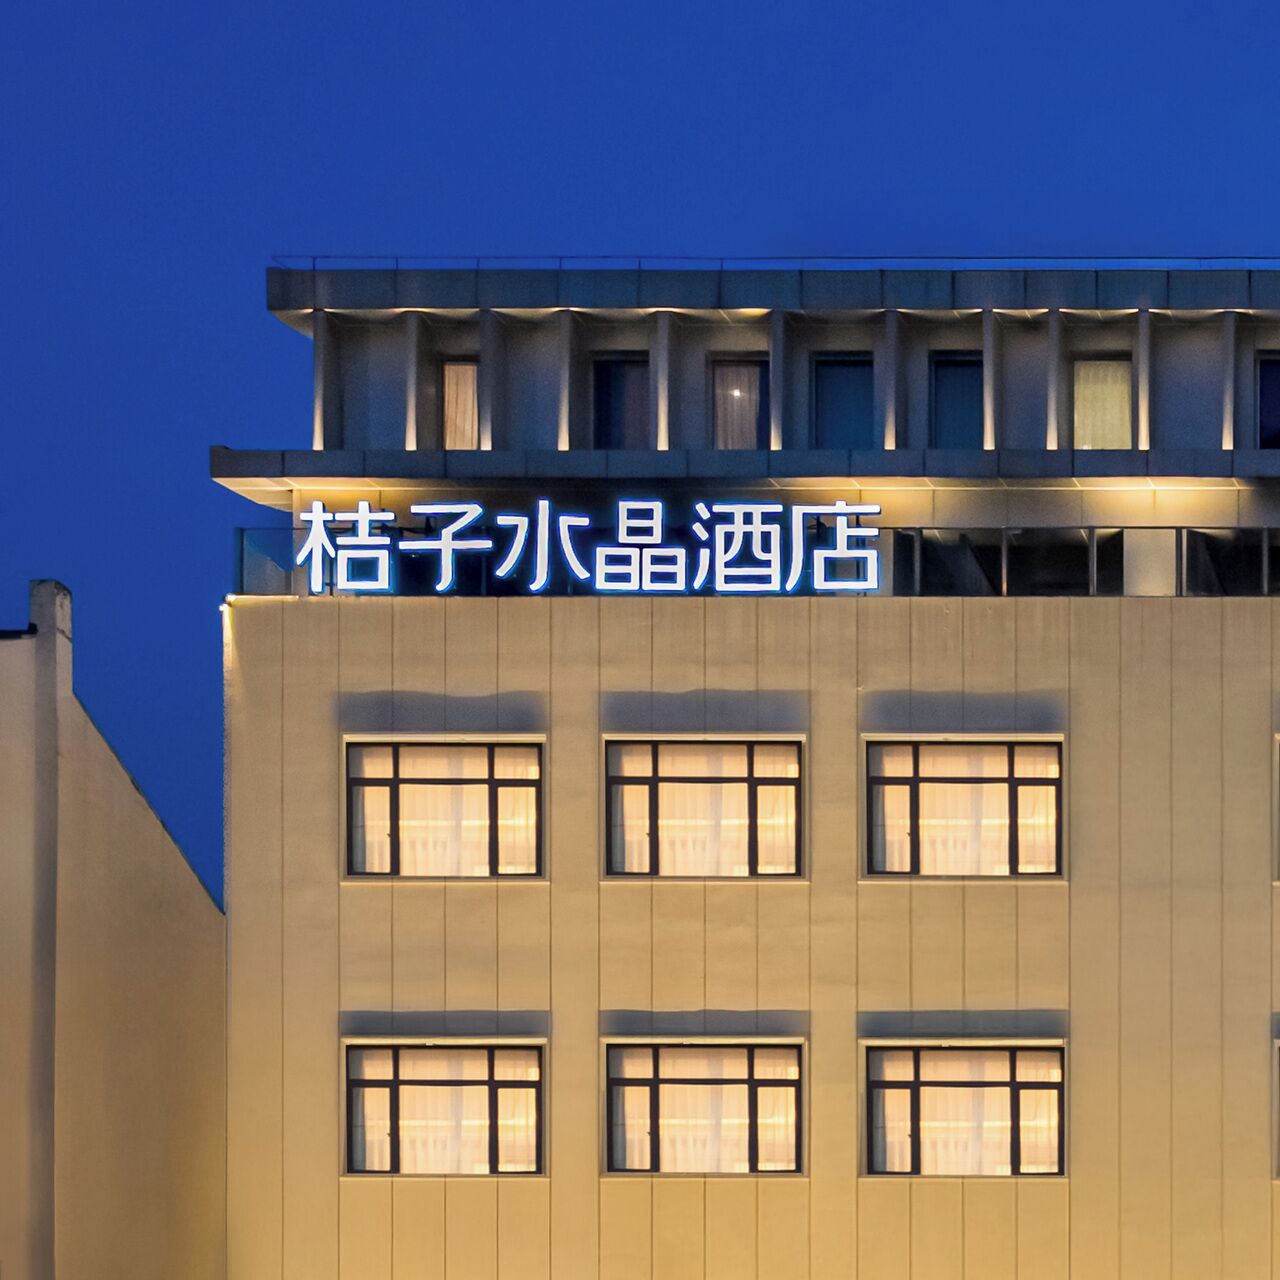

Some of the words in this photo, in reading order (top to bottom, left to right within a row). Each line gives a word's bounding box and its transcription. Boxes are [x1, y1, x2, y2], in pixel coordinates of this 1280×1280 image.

[296, 499, 881, 592] 桔子水晶酒店
